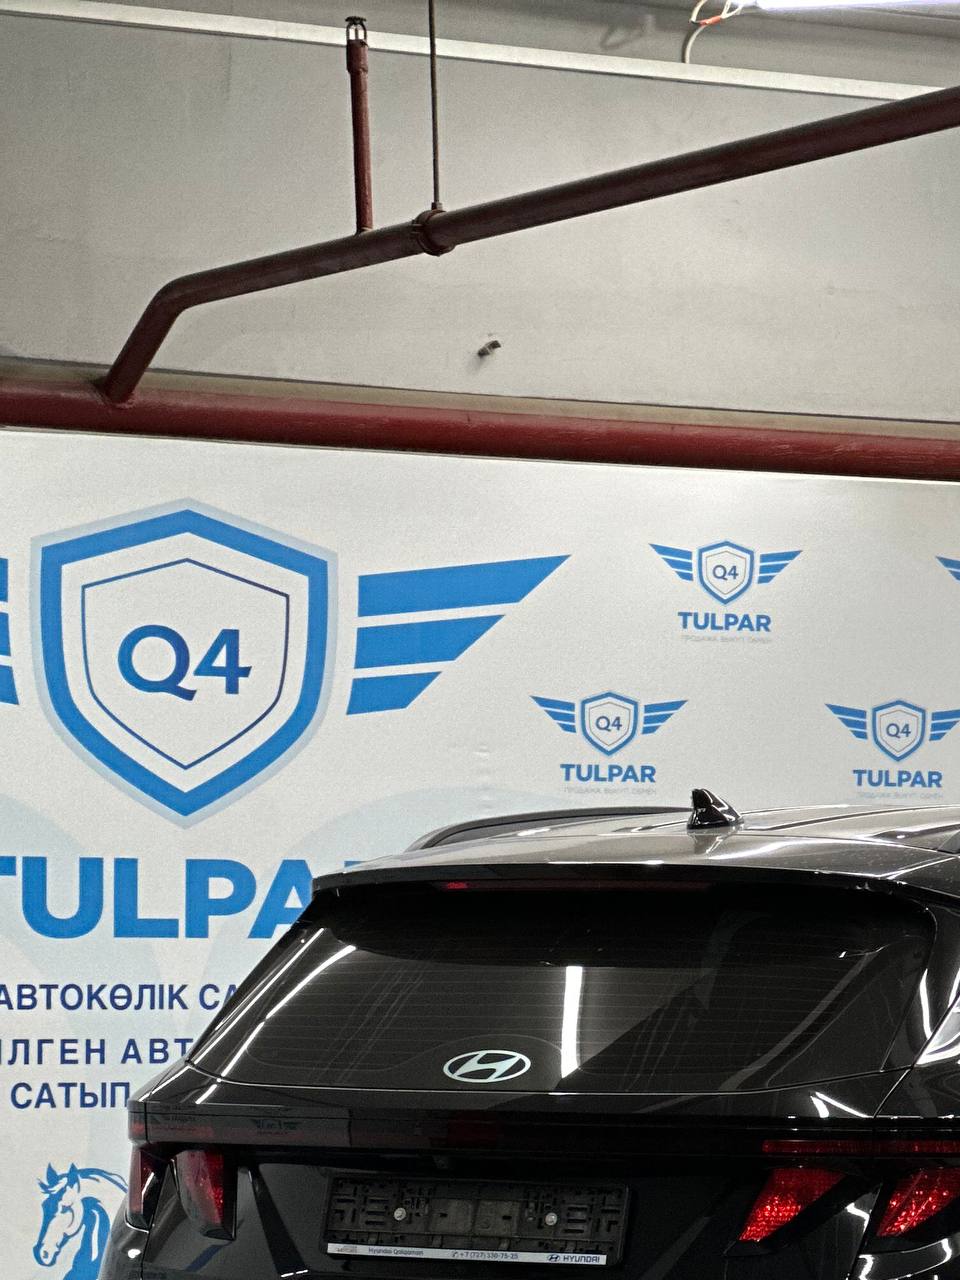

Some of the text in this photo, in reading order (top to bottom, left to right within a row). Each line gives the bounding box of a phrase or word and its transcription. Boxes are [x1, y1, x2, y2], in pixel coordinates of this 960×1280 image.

[712, 564, 739, 581] Q4
[678, 612, 771, 632] TULPAR
[118, 625, 252, 701] Q4
[596, 716, 622, 732] Q4
[886, 723, 911, 738] Q4
[560, 764, 656, 783] TULPAR
[852, 769, 942, 788] TULPAR
[0, 856, 345, 939] ULPA
[10, 1082, 130, 1109] САТЫП
[563, 1255, 600, 1263] HYUNDAI
